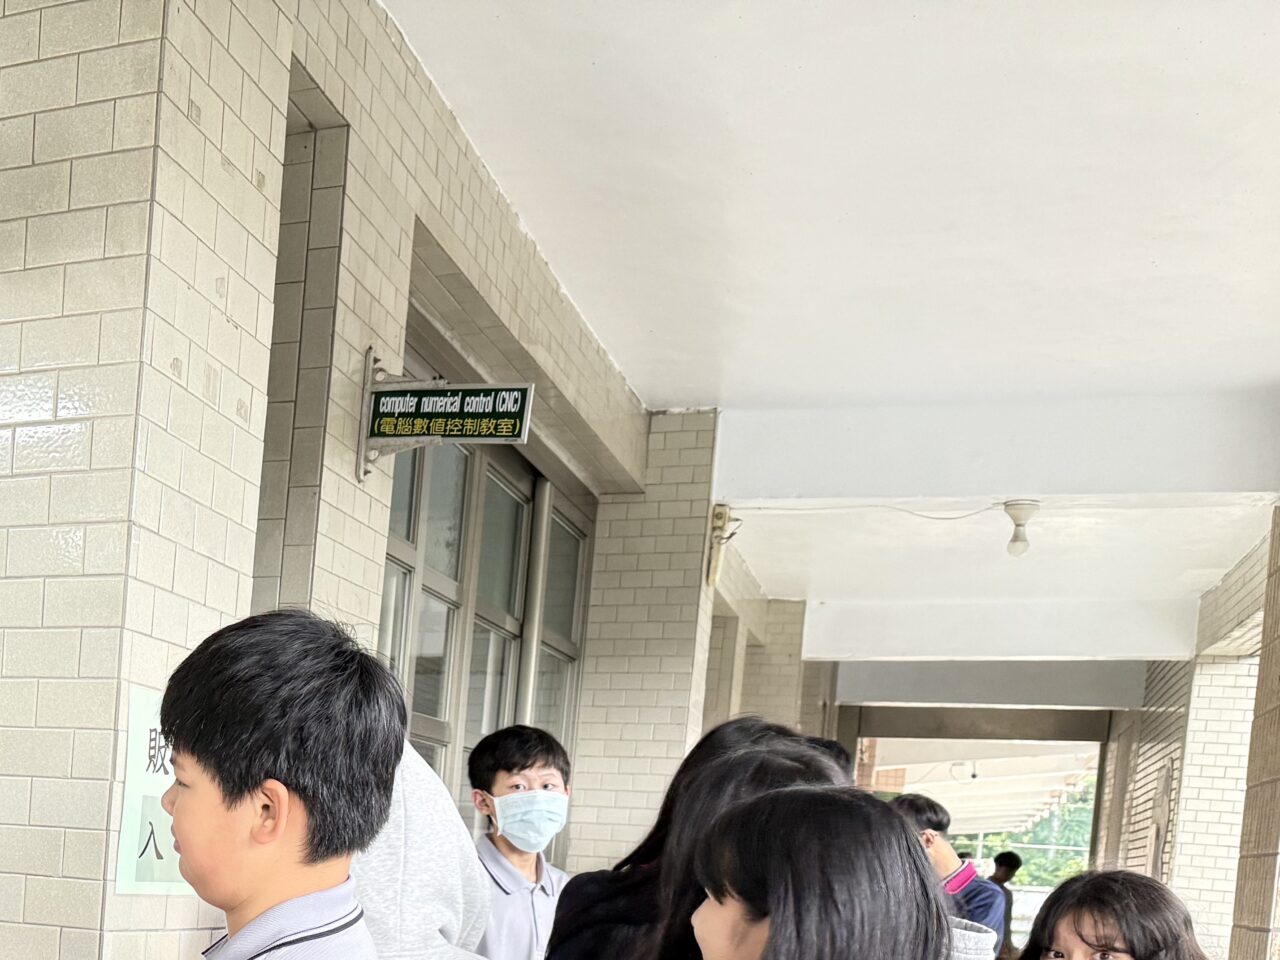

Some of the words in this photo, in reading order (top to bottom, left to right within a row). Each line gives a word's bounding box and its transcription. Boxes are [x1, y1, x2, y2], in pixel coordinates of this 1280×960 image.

[379, 393, 418, 416] computer
[420, 392, 461, 413] numerical
[463, 392, 494, 413] control
[496, 391, 522, 413] (CNC)
